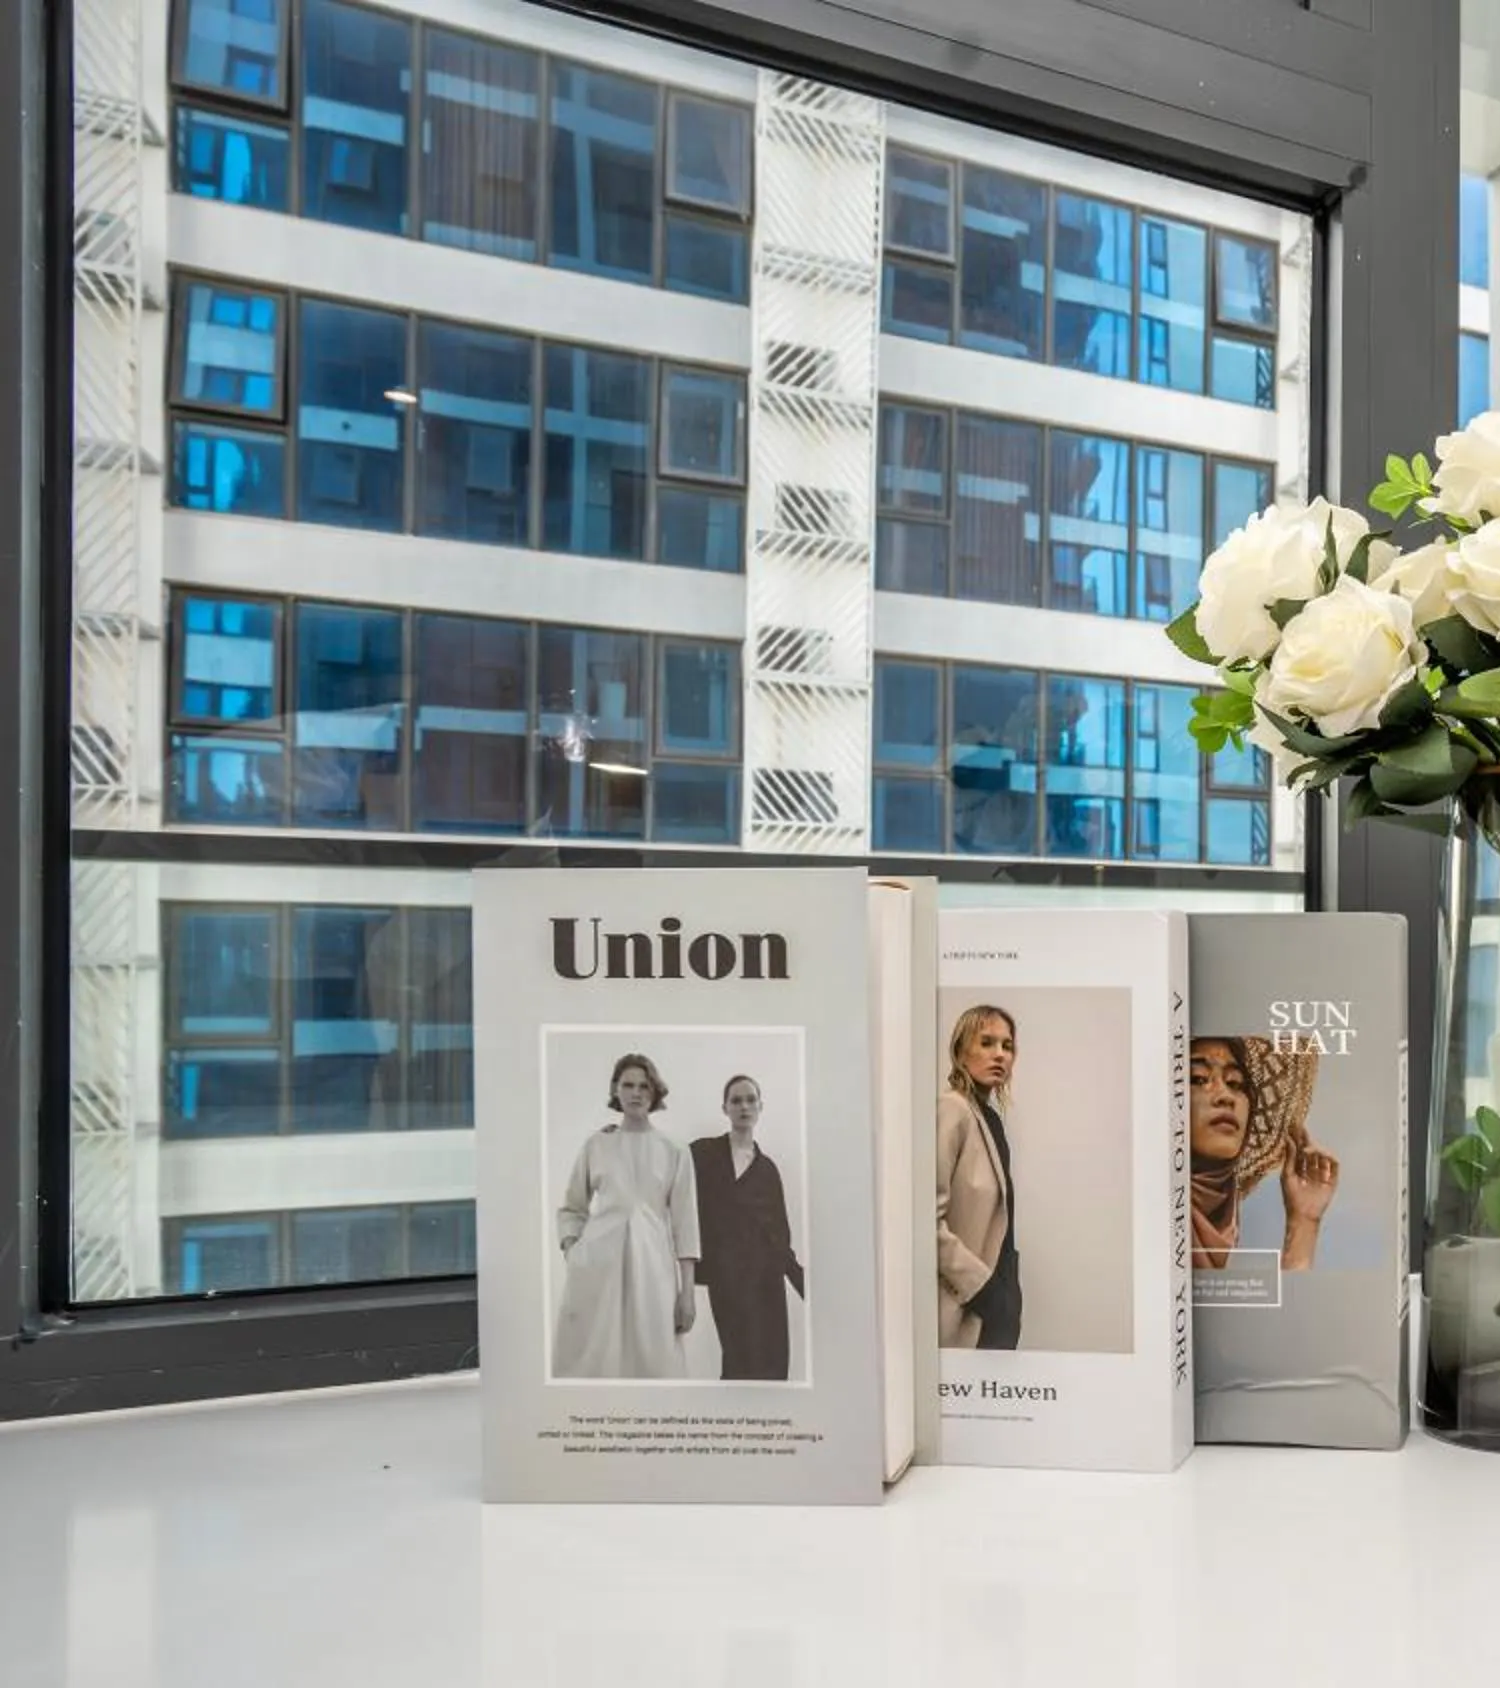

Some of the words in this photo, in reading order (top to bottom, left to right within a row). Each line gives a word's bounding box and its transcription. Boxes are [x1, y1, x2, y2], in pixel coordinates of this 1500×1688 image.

[548, 916, 791, 981] Union
[1173, 991, 1184, 1013] A
[1269, 1001, 1353, 1028] SUN
[1173, 1024, 1185, 1110] TRIP
[1269, 1029, 1358, 1056] HAT
[1173, 1121, 1186, 1172] TO
[1174, 1185, 1186, 1270] NEW
[1175, 1283, 1188, 1390] YORK
[938, 1383, 973, 1398] ew
[981, 1380, 1058, 1401] Haven
